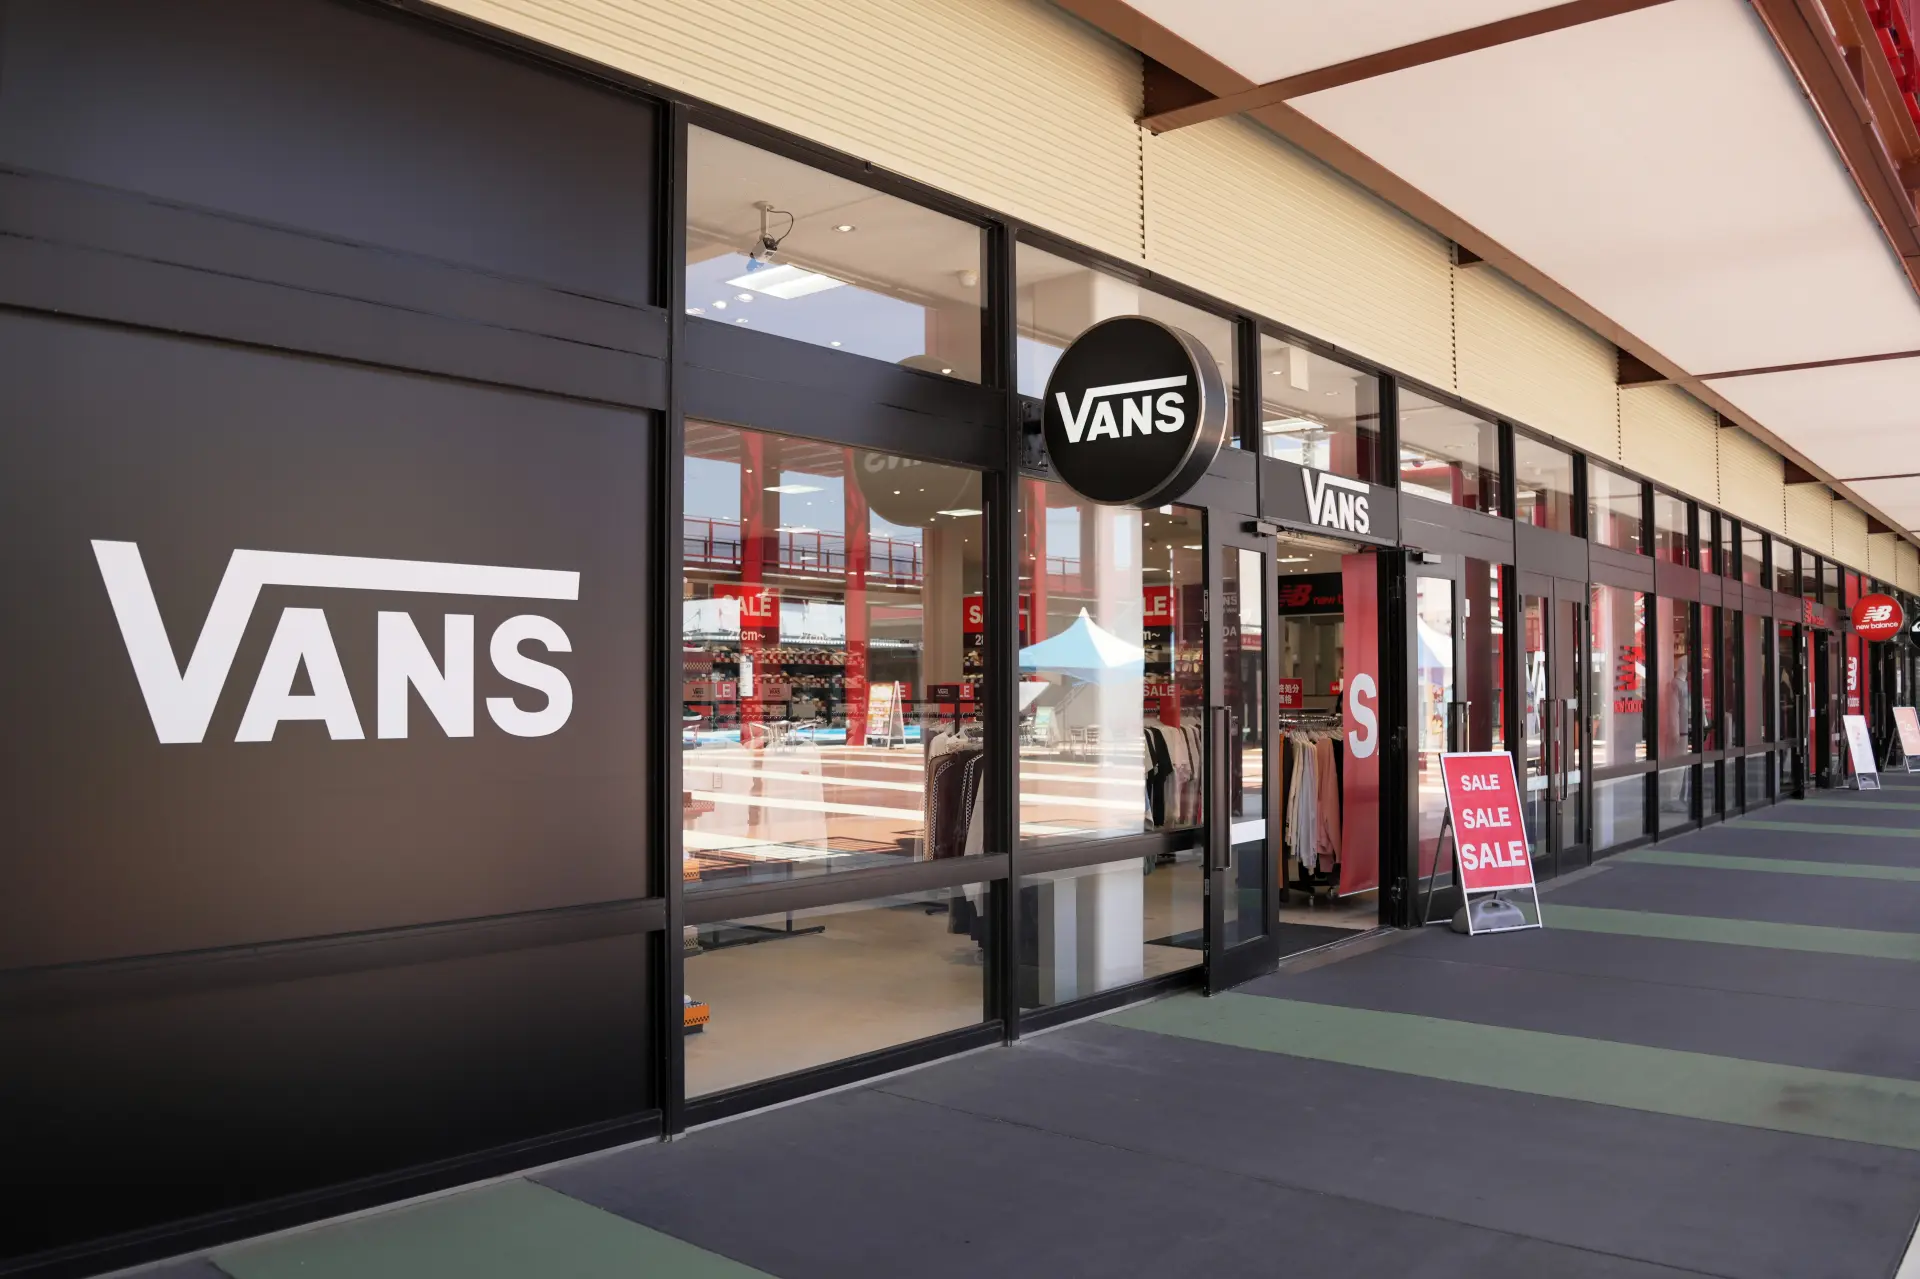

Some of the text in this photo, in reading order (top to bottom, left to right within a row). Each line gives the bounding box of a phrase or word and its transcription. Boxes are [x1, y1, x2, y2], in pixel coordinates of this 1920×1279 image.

[1055, 375, 1188, 443] VANS
[1302, 468, 1370, 534] VANS
[722, 594, 772, 617] ALE
[969, 604, 984, 624] S
[1143, 595, 1168, 616] LE
[1872, 622, 1899, 630] balance
[90, 539, 580, 744] VANS
[715, 683, 732, 698] LE
[1349, 673, 1379, 758] S
[1461, 774, 1500, 792] SALE
[1463, 807, 1511, 829] SALE
[1463, 841, 1526, 870] SALE
